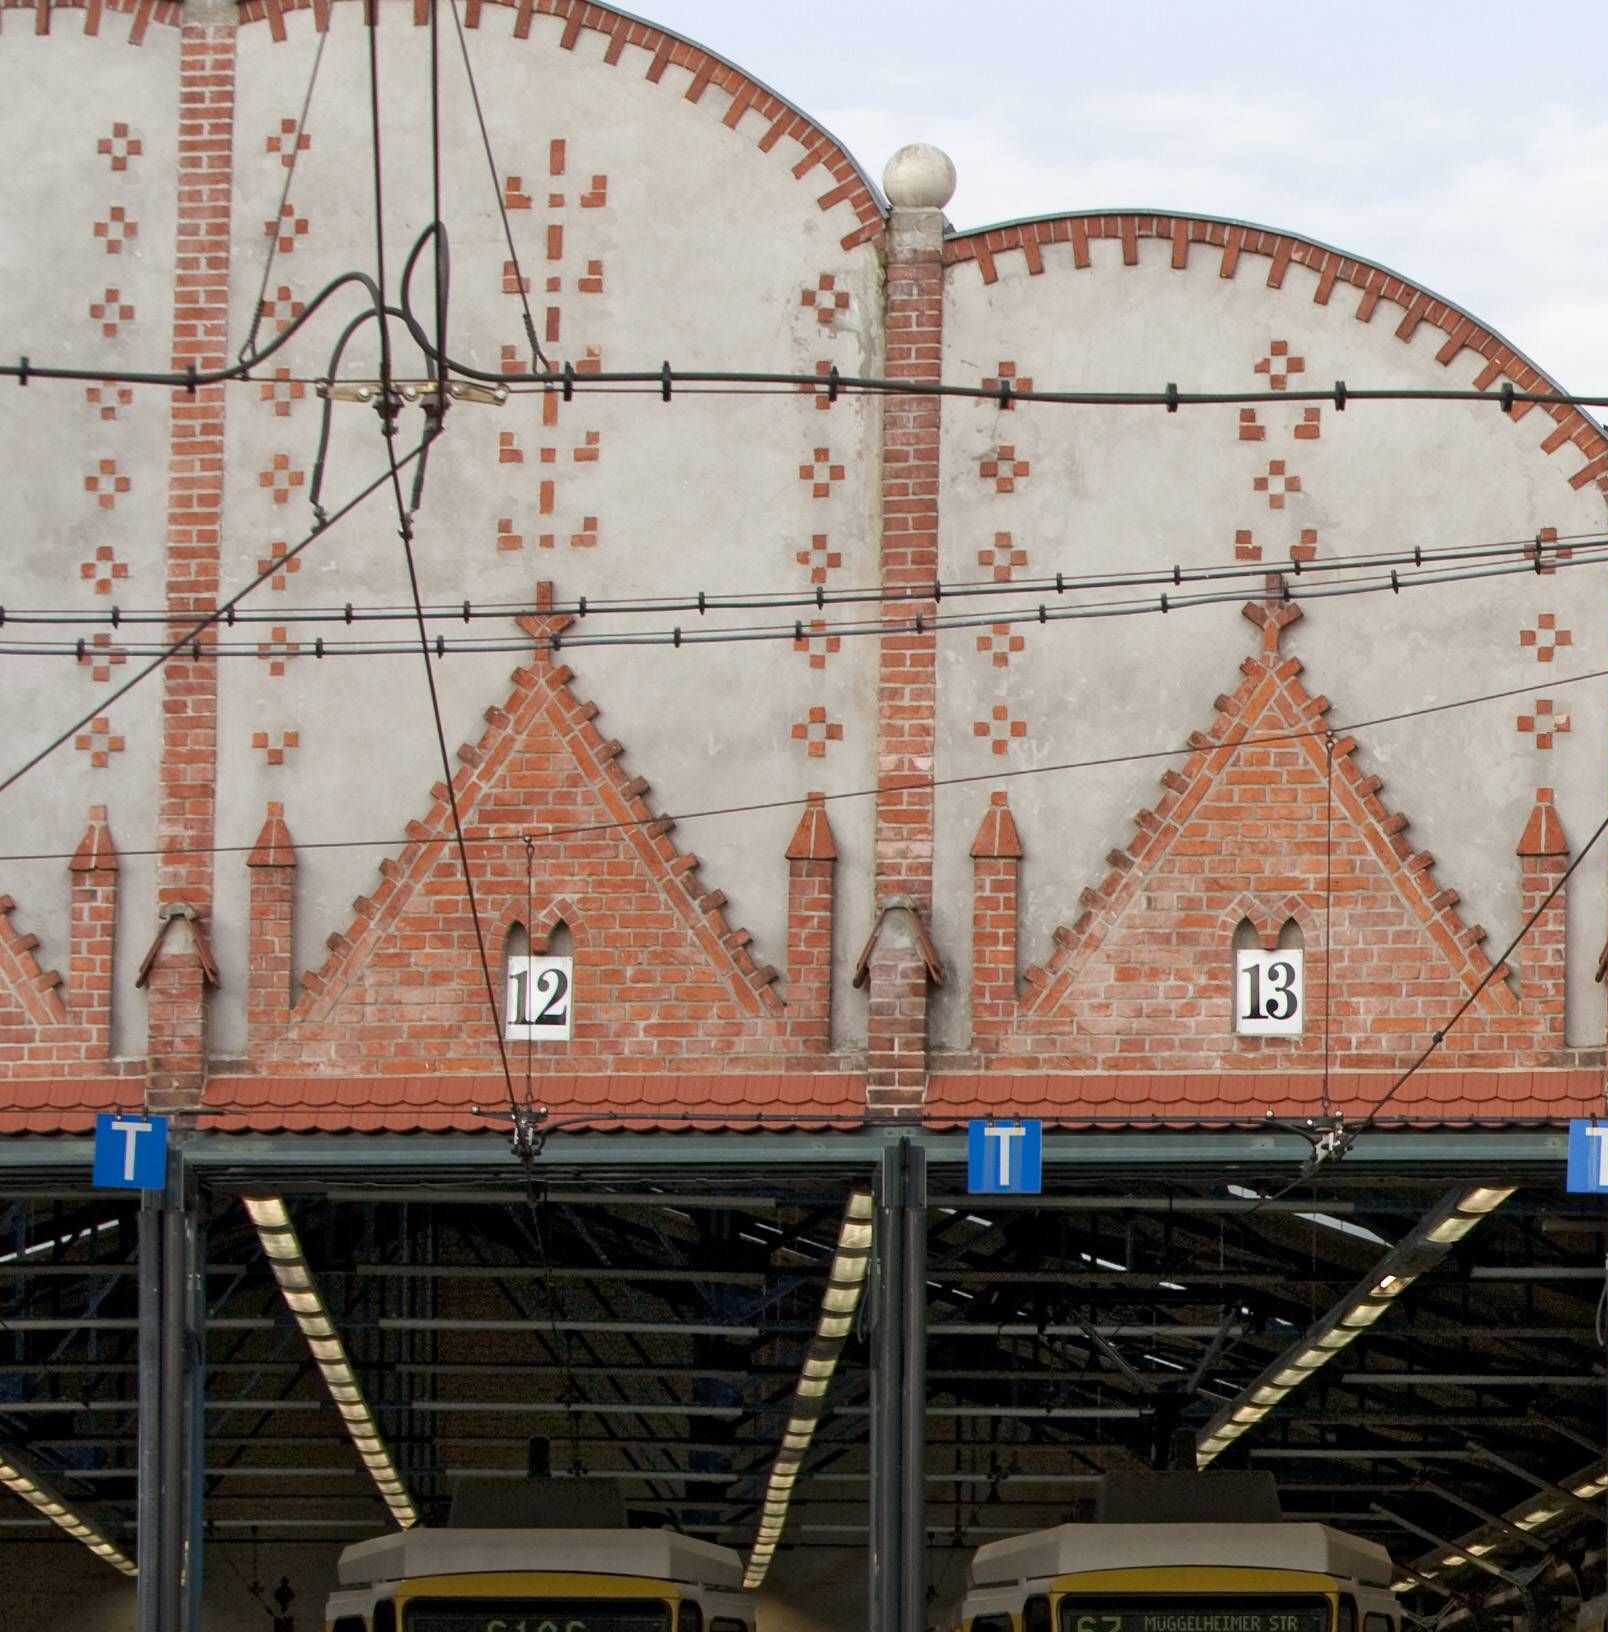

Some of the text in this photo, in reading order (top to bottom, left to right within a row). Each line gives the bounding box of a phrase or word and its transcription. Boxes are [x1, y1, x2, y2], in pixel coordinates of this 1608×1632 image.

[508, 968, 568, 1027] 12
[1242, 961, 1298, 1020] 13
[112, 1122, 151, 1180] T
[984, 1127, 1025, 1185] T
[1143, 1614, 1261, 1632] MÜGGELHEIMER
[1269, 1615, 1298, 1632] STR
